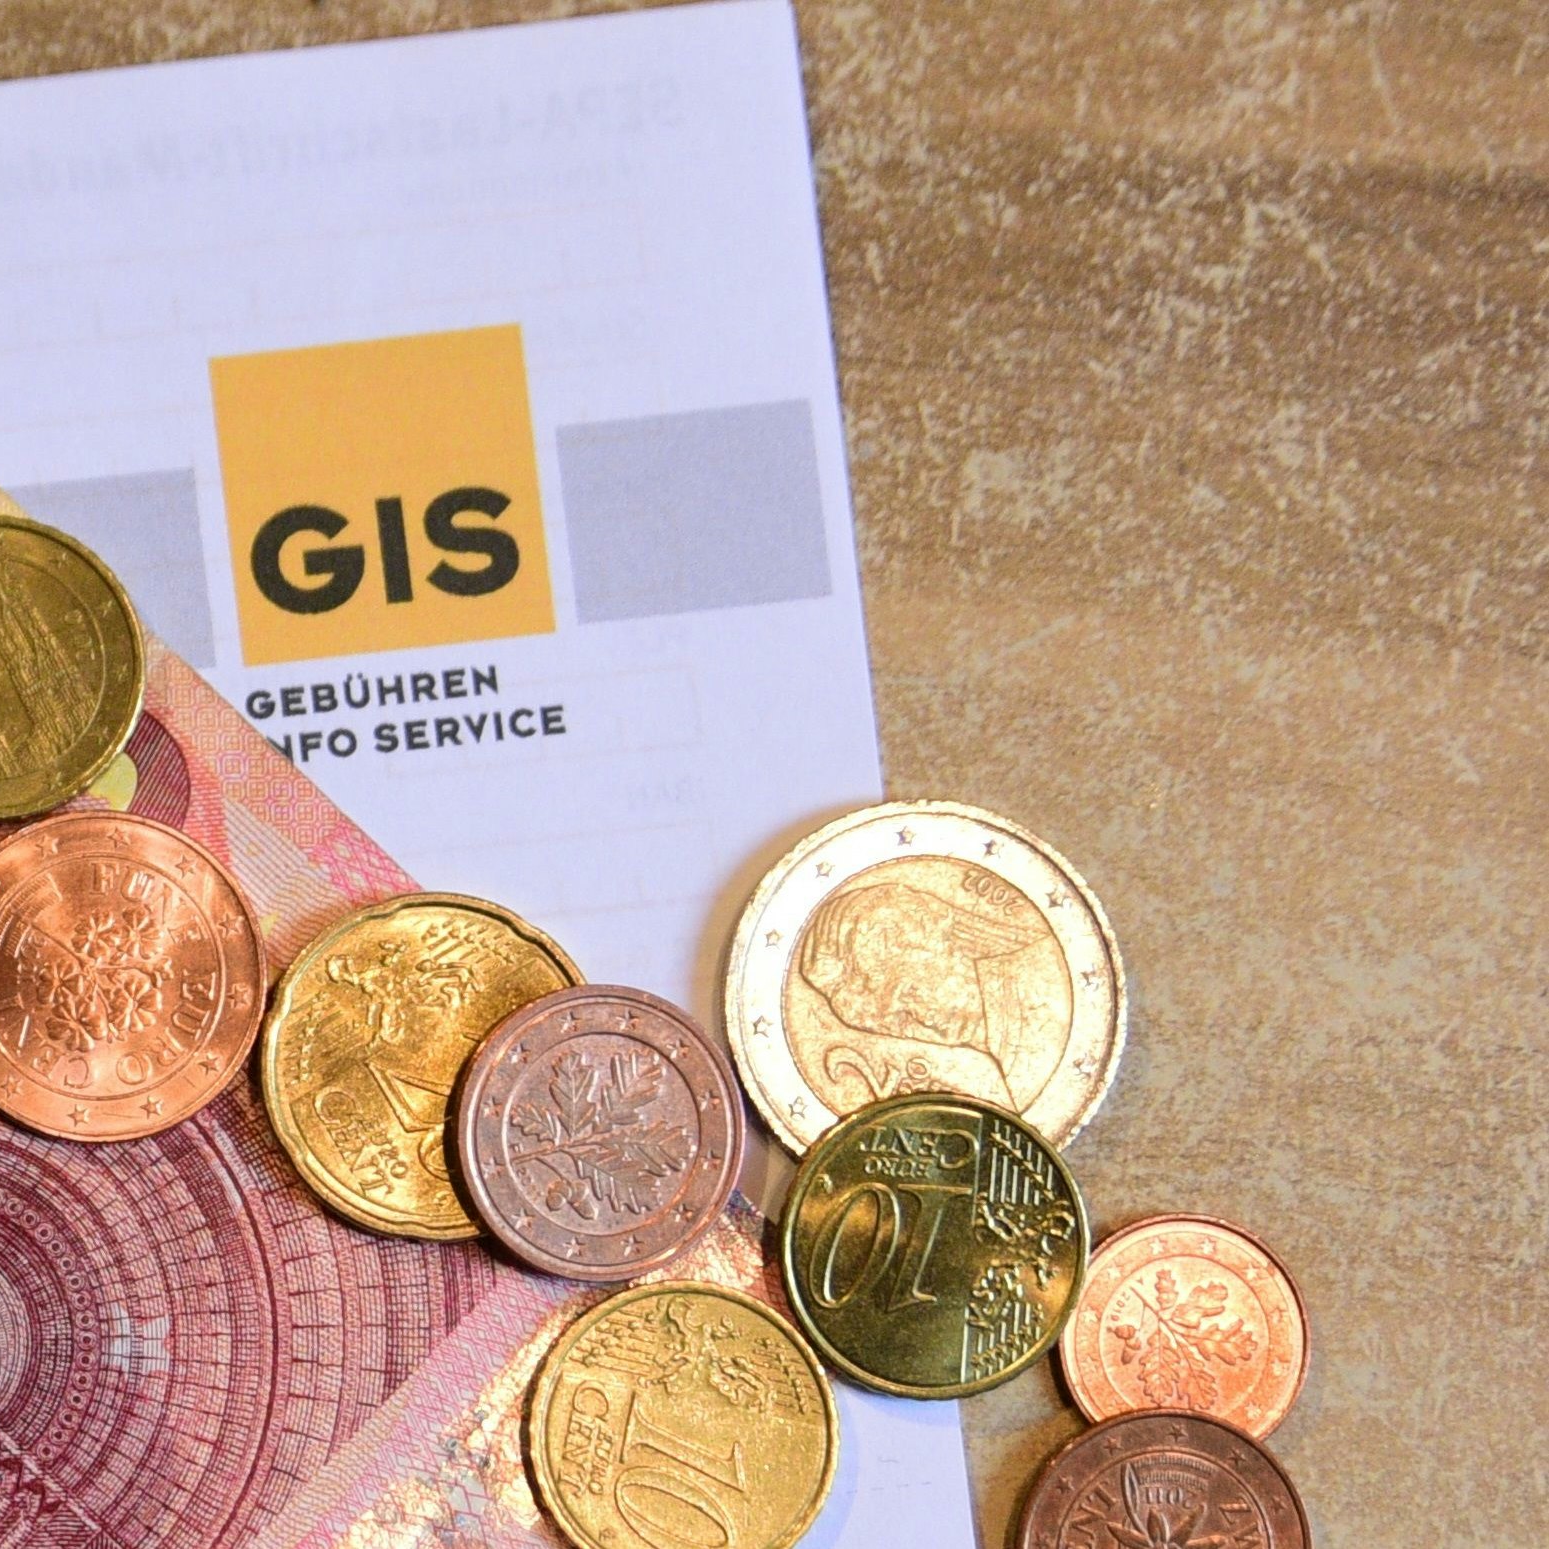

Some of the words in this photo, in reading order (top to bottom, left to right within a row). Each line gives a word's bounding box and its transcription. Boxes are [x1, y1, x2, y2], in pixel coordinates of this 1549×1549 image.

[250, 486, 520, 615] GIS
[245, 664, 499, 720] GEBÜHREN
[265, 726, 358, 764] NFO
[373, 704, 567, 754] SERVICE
[960, 868, 1024, 917] 2002
[313, 1086, 395, 1199] CENT
[858, 1124, 980, 1169] CENT
[809, 1182, 974, 1313] 10
[558, 1379, 610, 1499] CENT
[614, 1390, 750, 1549] 10
